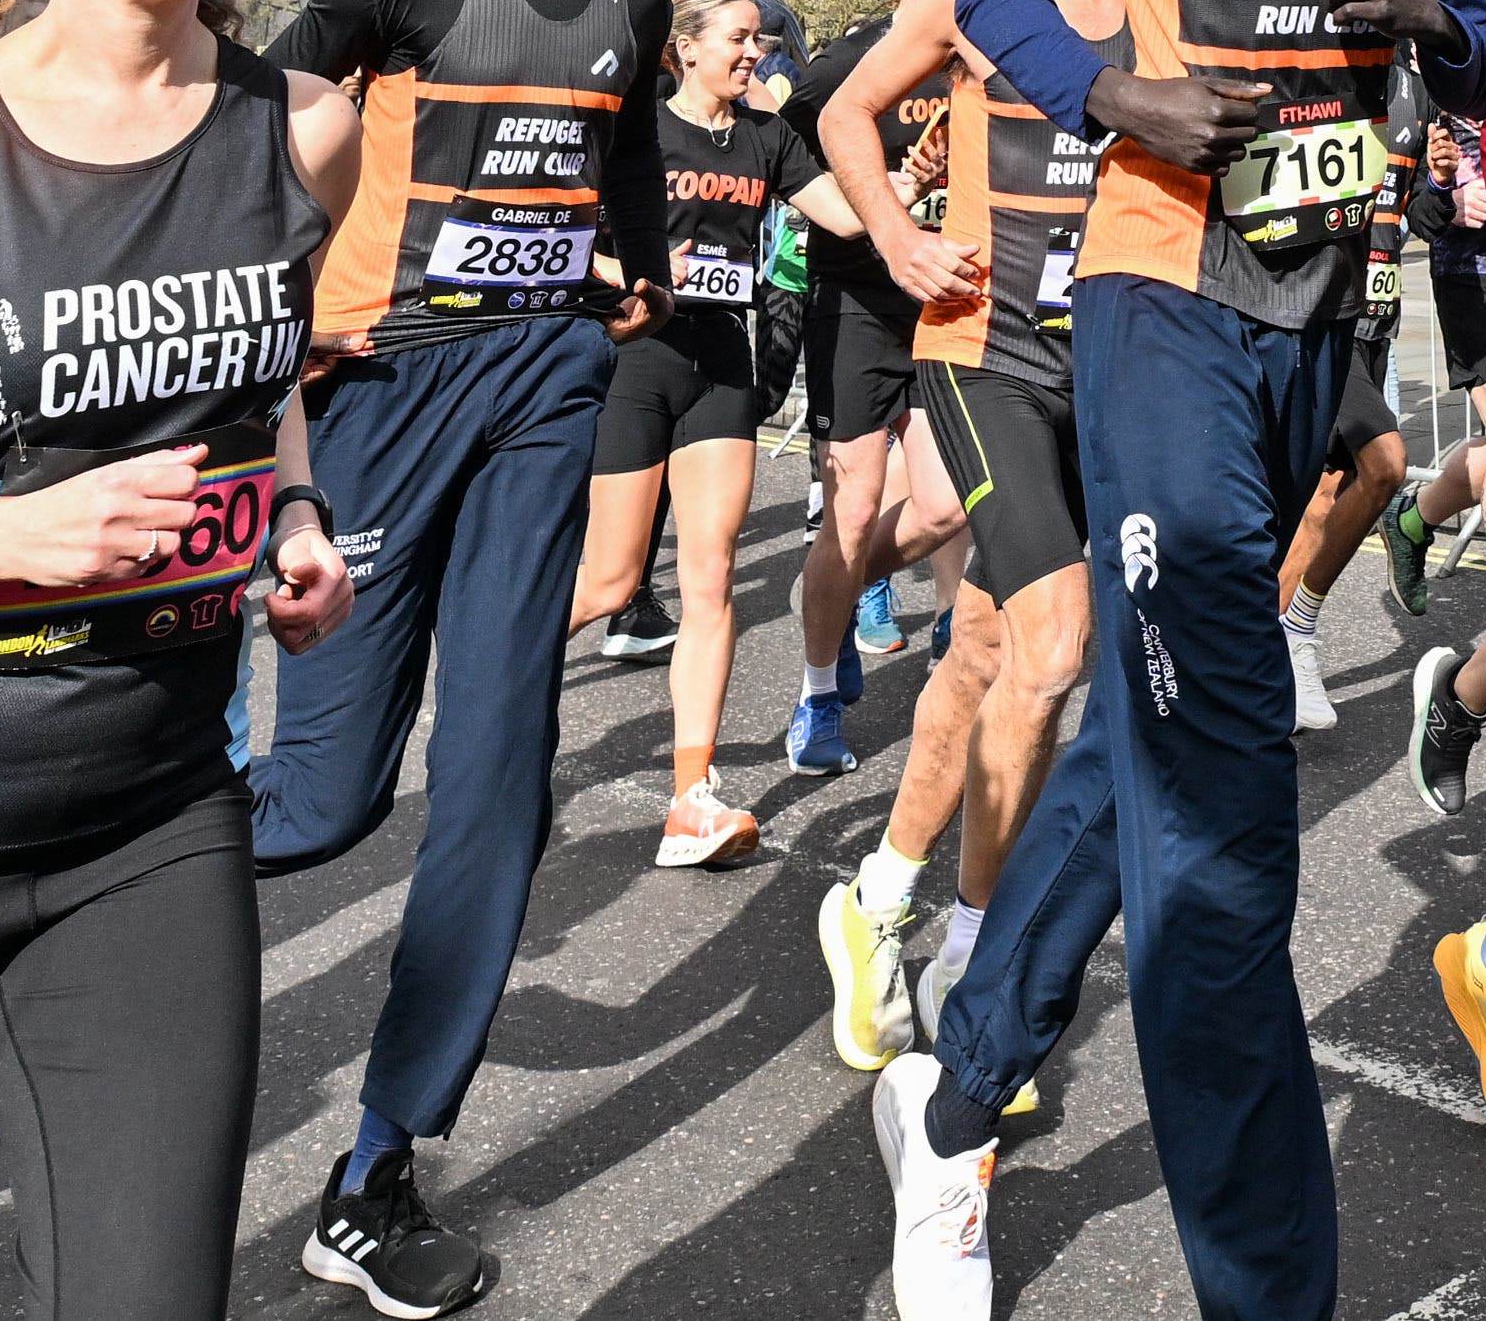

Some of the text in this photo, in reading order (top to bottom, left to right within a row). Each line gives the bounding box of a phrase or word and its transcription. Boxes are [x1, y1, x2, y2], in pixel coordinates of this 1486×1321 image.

[1255, 5, 1319, 35] RUN
[898, 98, 949, 125] COO
[1279, 101, 1343, 125] FTHAWI
[480, 149, 586, 177] RUN CLUB
[1045, 161, 1094, 186] RUN
[1249, 134, 1364, 197] 7161
[491, 207, 572, 225] GABRIEL DE
[456, 235, 574, 277] 2838
[696, 243, 728, 257] ESMÉE
[43, 260, 292, 352] PROSTATE
[39, 319, 305, 419] CANCER UK
[1140, 626, 1156, 656] NEW
[1148, 624, 1179, 700] CANTERBURY
[1146, 657, 1171, 718] ZEALAND
